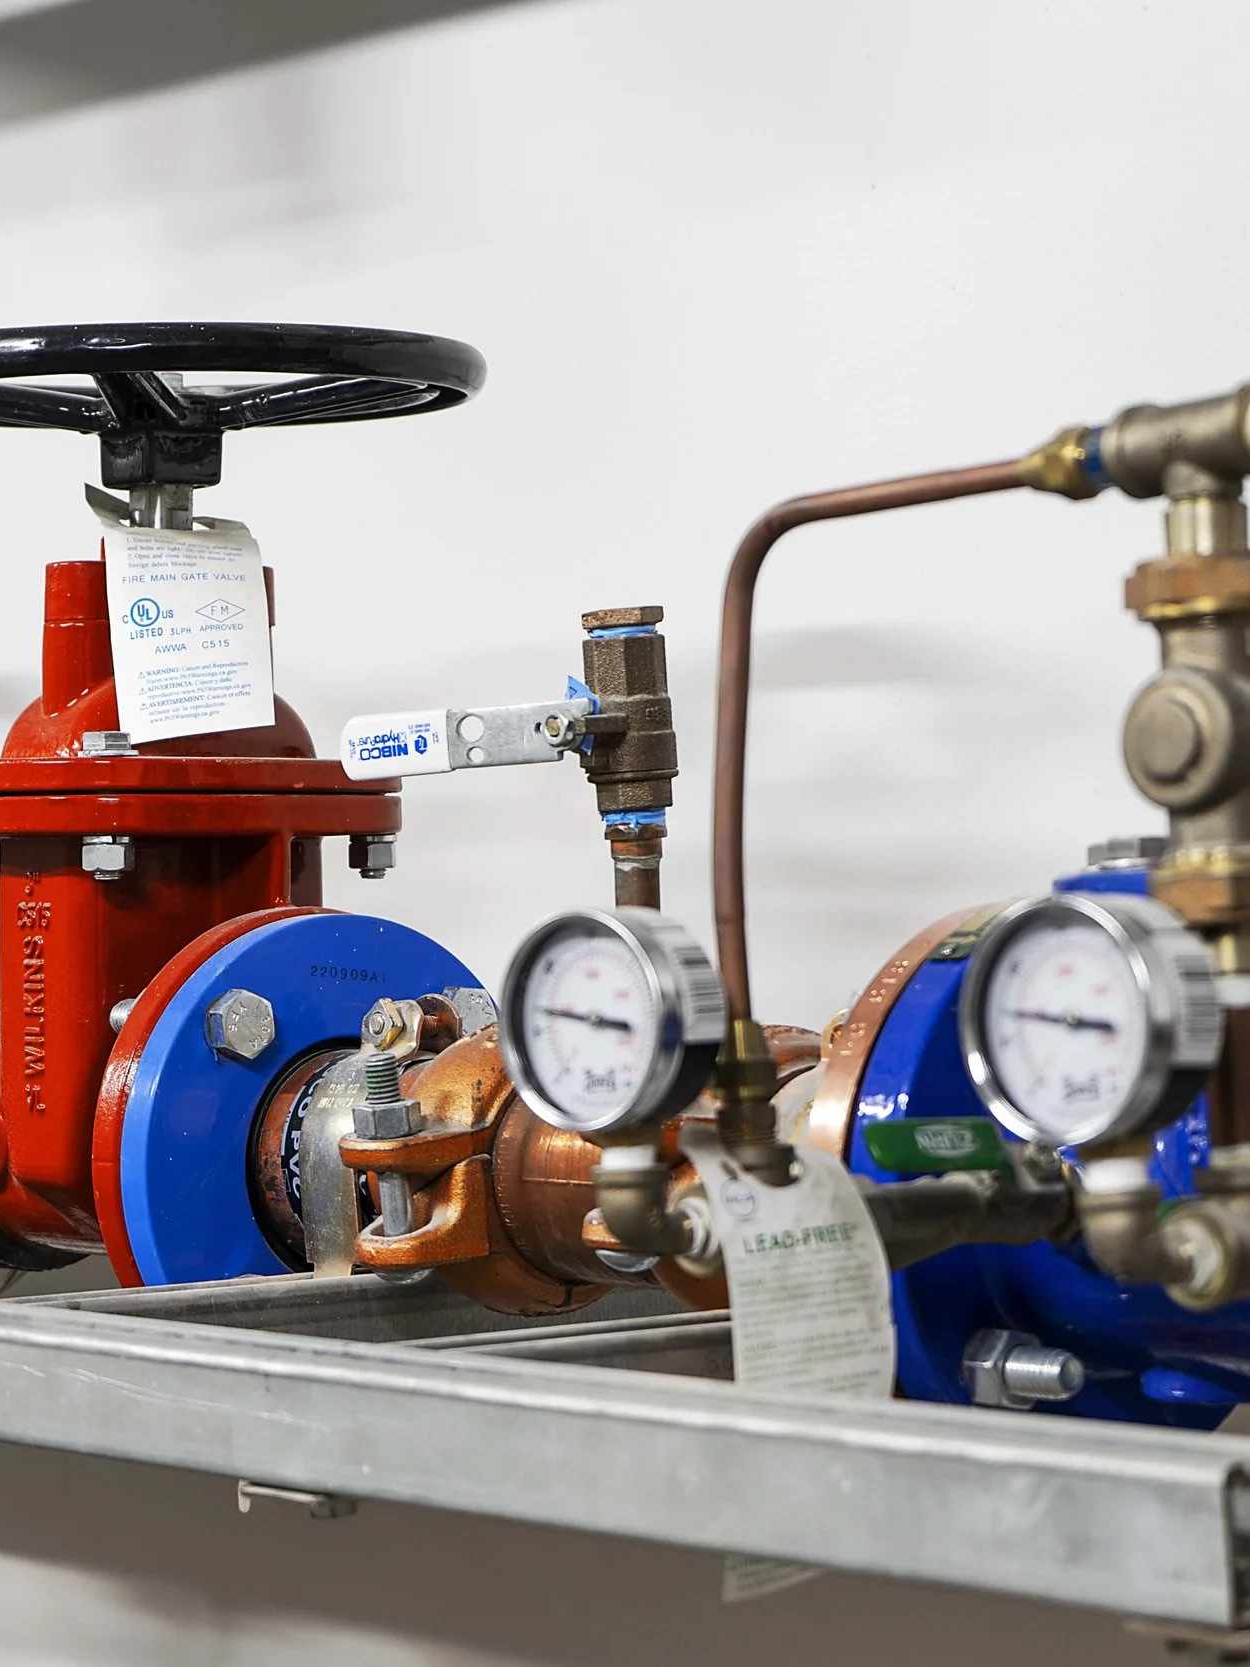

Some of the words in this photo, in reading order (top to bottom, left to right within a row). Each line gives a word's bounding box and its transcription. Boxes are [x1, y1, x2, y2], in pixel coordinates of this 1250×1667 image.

[122, 574, 146, 585] FIRE
[150, 573, 176, 582] MAIN
[181, 573, 209, 581] GATE
[213, 573, 247, 582] VALVE
[161, 609, 174, 620] US
[130, 627, 164, 640] LISTED
[170, 627, 192, 636] 3LPH
[199, 623, 244, 633] APPROVED
[155, 643, 187, 655] AWWA
[201, 639, 230, 650] C515
[359, 743, 409, 761] NIBCO
[23, 935, 46, 1077] WILKINS
